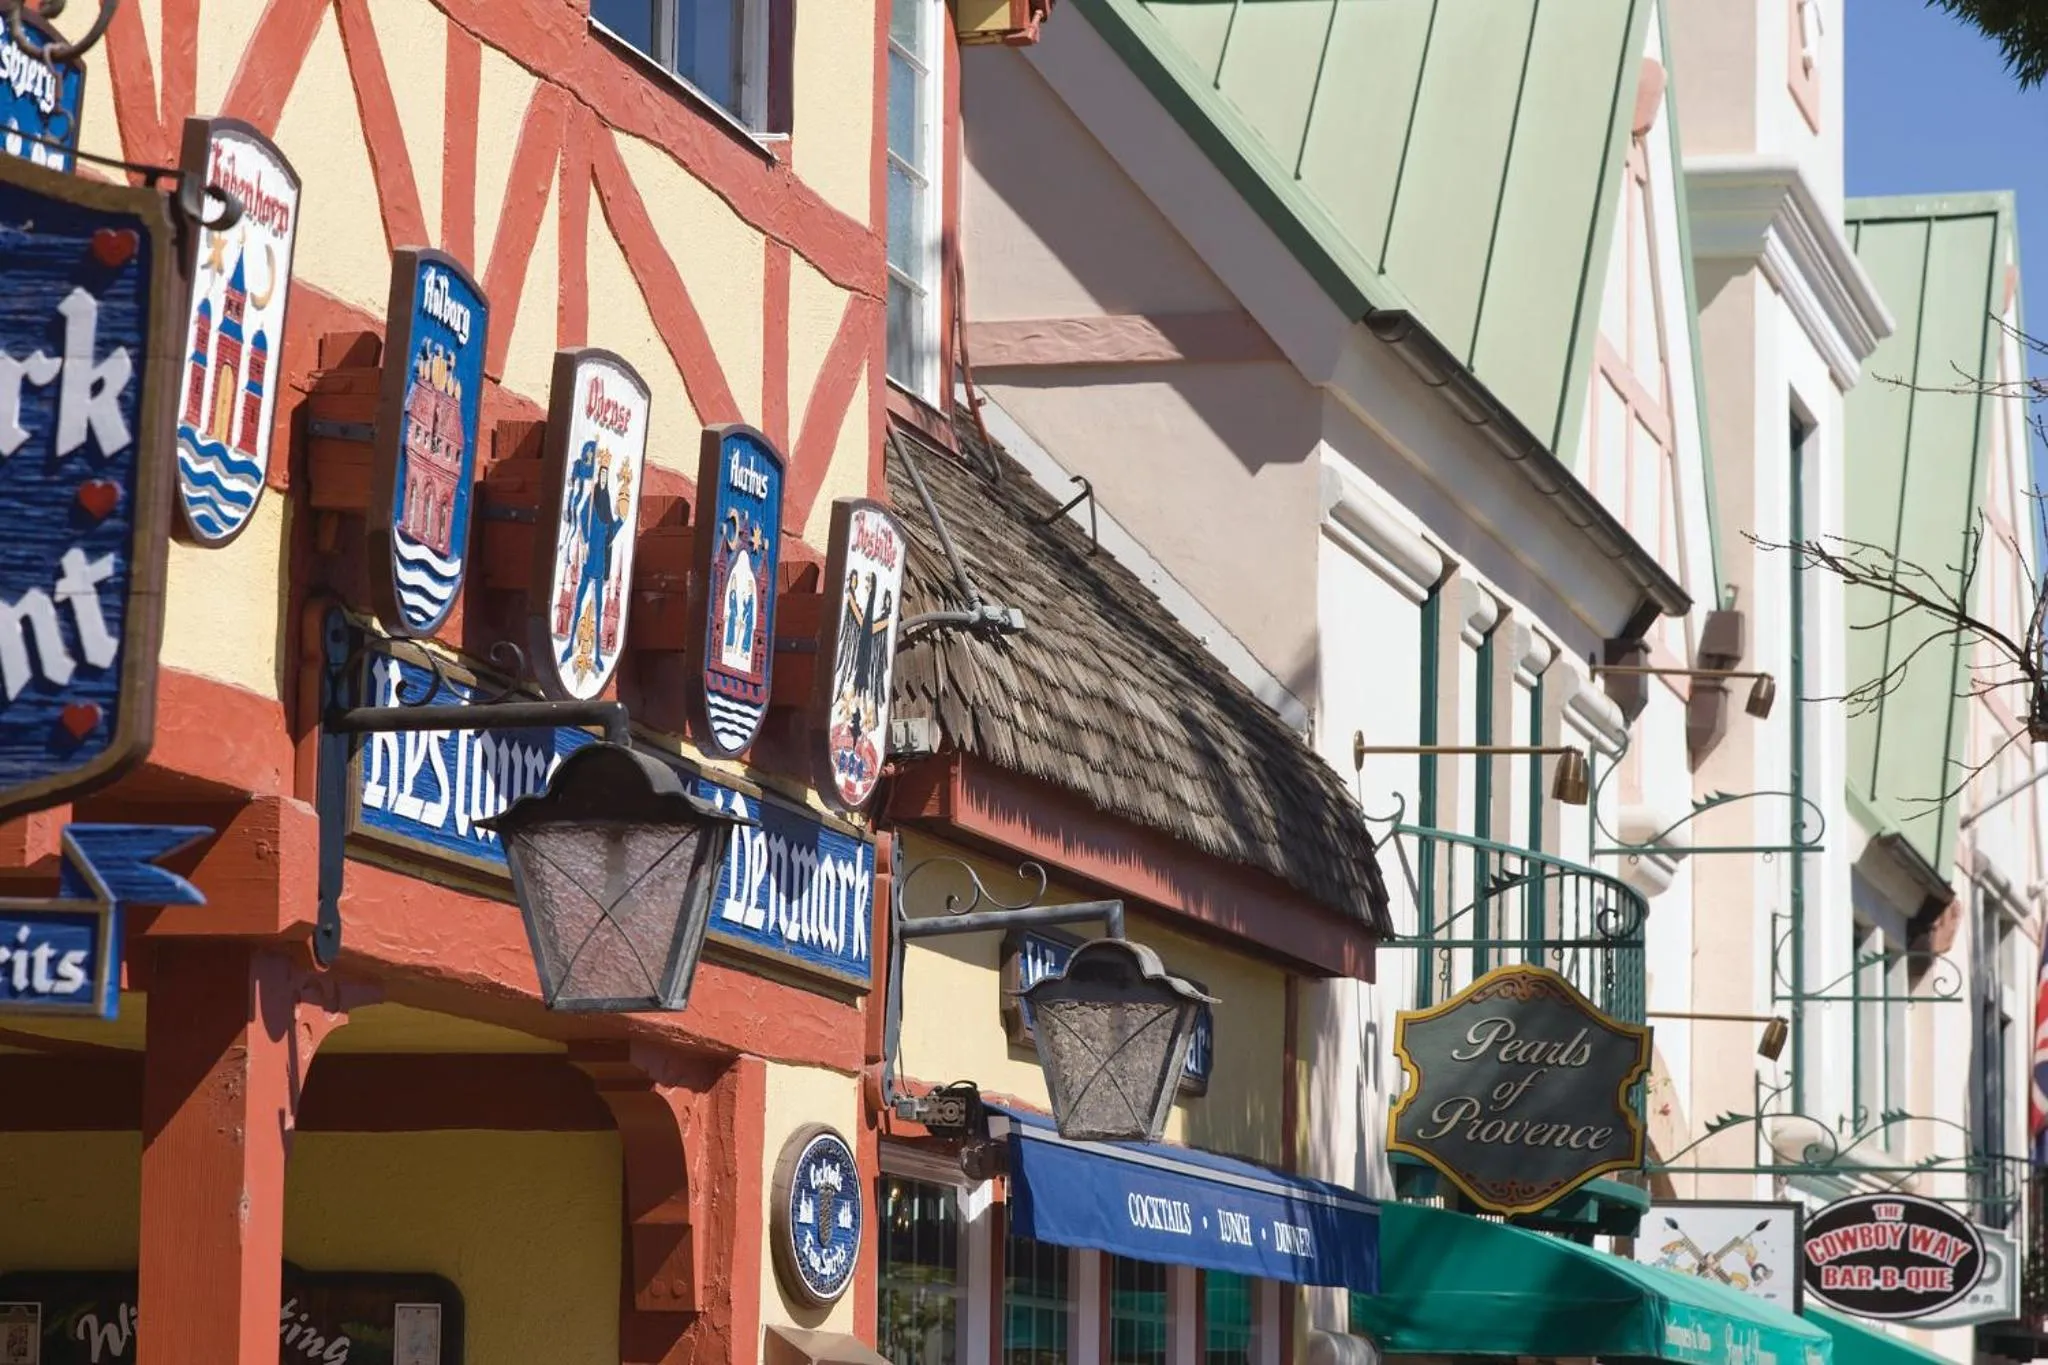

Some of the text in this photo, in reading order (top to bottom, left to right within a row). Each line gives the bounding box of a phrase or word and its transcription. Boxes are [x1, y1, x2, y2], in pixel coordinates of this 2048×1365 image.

[1452, 1017, 1592, 1066] Pearls
[1489, 1068, 1547, 1111] of
[1417, 1097, 1612, 1150] Provence
[1128, 1192, 1314, 1258] COCKTAILS LUNCH DINNER
[1873, 1203, 1904, 1220] THE
[1805, 1222, 1972, 1266] COWBOY WAY
